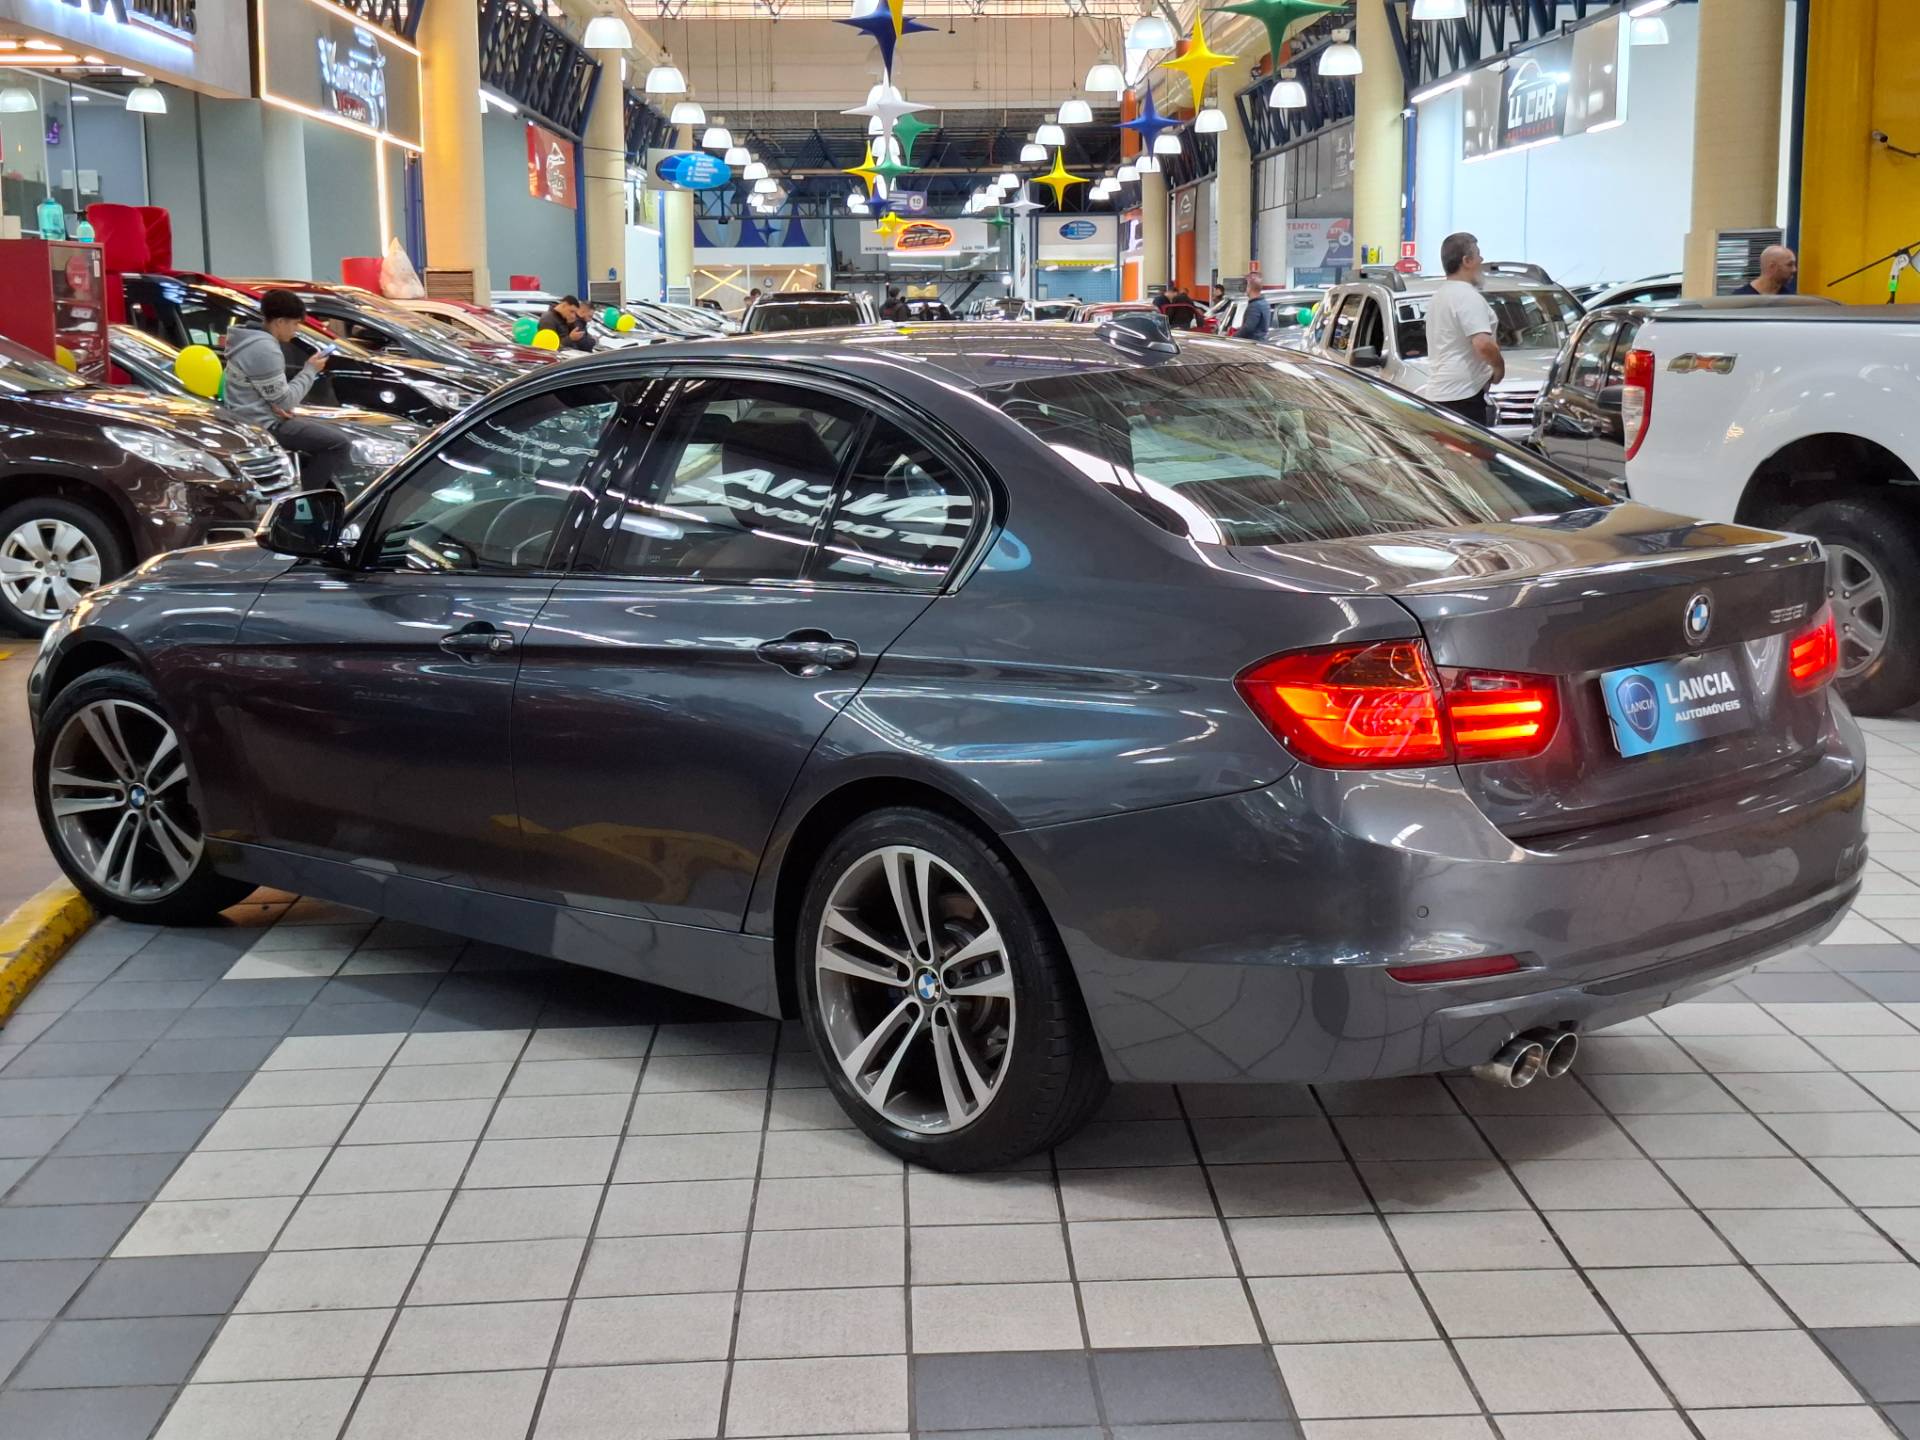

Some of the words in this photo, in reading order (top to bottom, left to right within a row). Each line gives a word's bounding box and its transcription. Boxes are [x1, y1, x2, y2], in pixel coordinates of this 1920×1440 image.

[1507, 95, 1523, 129] LL
[1525, 83, 1557, 124] CAR
[1665, 671, 1736, 705] LANCIA
[1675, 699, 1741, 722] AUTOMÓVEIS
